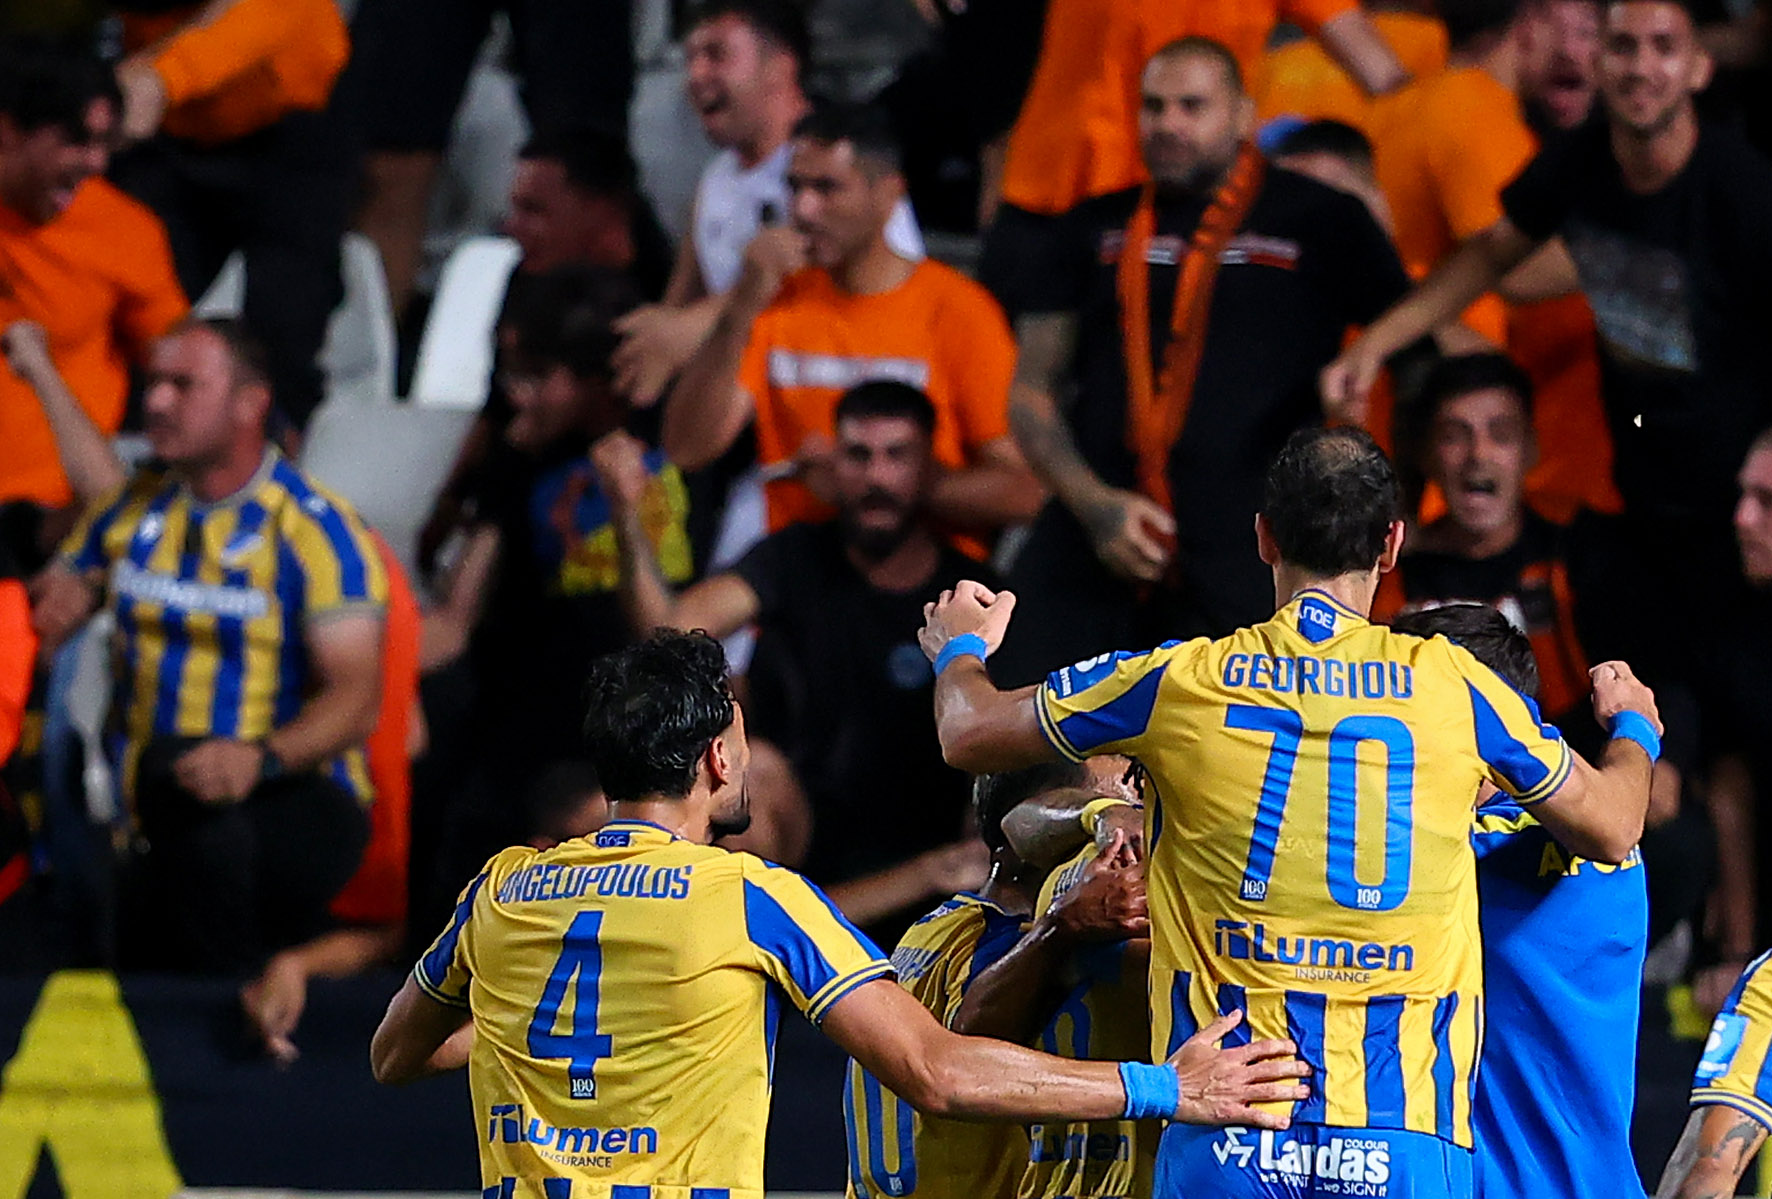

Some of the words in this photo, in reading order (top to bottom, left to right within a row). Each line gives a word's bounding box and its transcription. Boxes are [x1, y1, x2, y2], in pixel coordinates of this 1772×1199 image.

[1223, 654, 1413, 699] GEORGIOU
[1224, 703, 1415, 912] 70
[498, 864, 693, 904] ANGELOPOULOS
[1242, 879, 1266, 895] 100
[1356, 888, 1382, 904] 100
[1253, 923, 1414, 971] Lumen
[1294, 967, 1371, 984] INSURANCE
[527, 910, 613, 1100] 4
[571, 1078, 594, 1094] 100
[519, 1104, 658, 1155] Lumen
[1344, 1138, 1389, 1151] COLOUR
[539, 1150, 613, 1169] INSURANCE
[1342, 1181, 1376, 1197] SIGN
